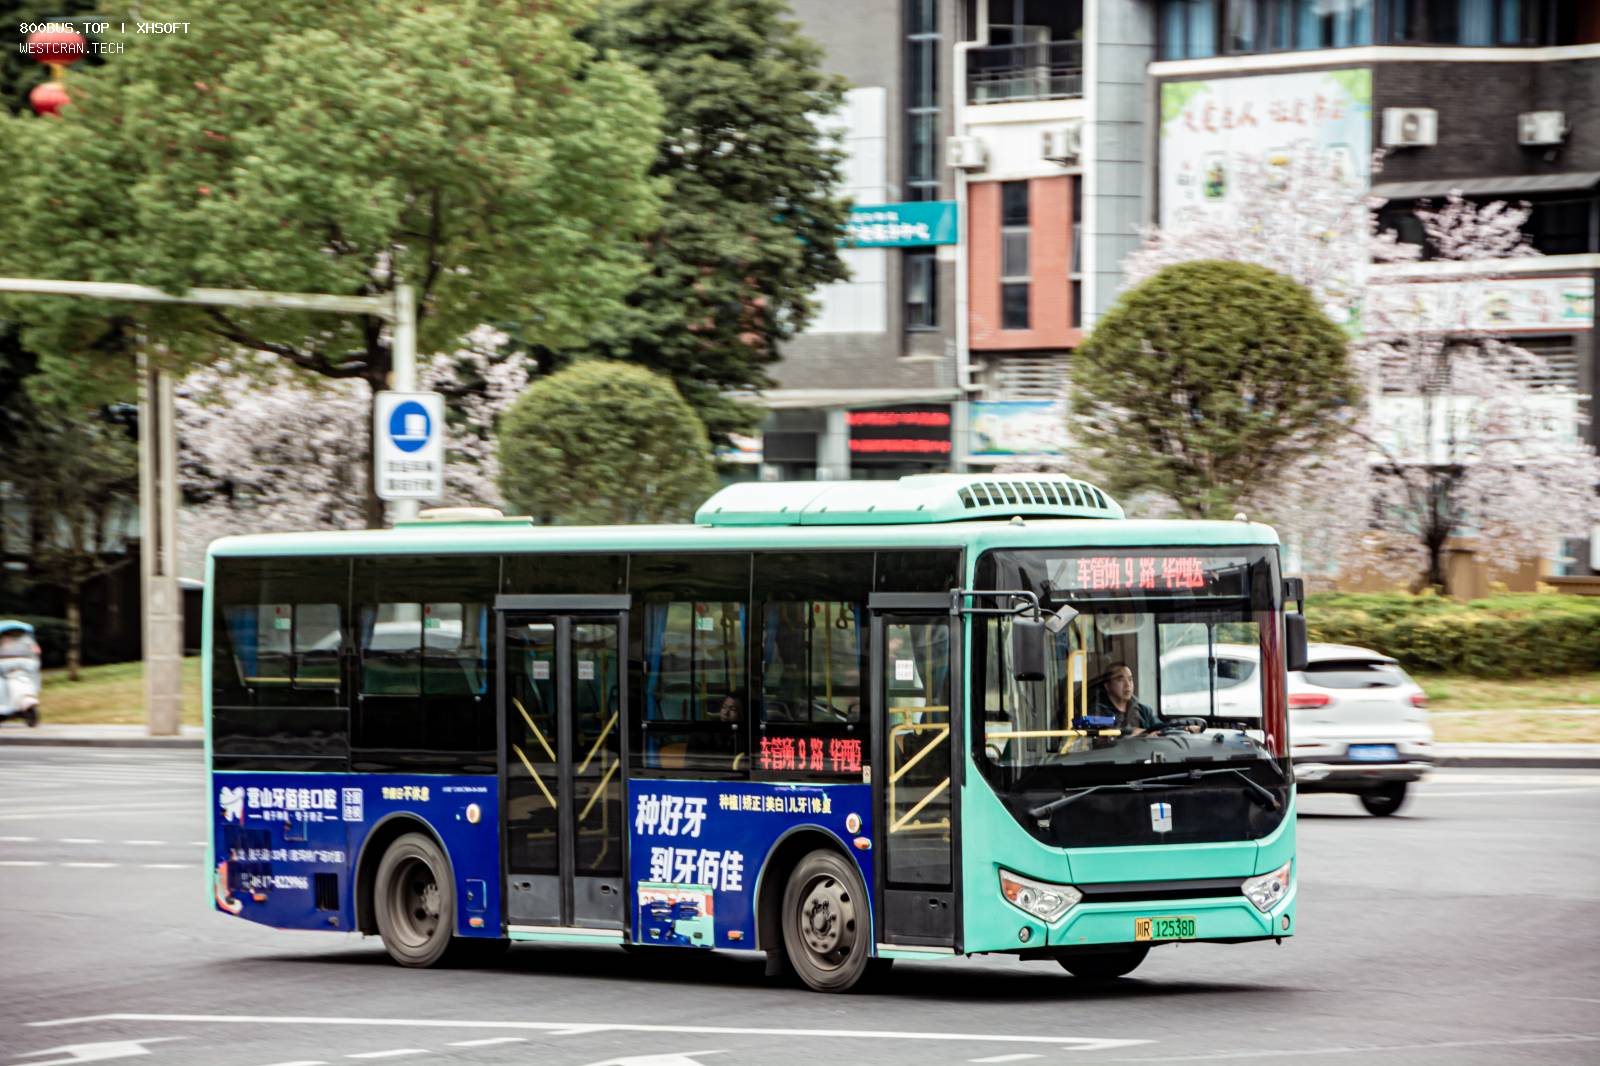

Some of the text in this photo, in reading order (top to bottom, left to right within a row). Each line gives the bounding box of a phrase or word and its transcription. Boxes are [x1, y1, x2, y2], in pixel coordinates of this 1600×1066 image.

[1077, 558, 1120, 589] 车管所
[1125, 558, 1133, 588] 9
[760, 737, 795, 770] 车管所
[798, 738, 806, 769] 9
[635, 794, 708, 838] 种好牙
[649, 847, 744, 892] 到牙佰佳
[1156, 919, 1195, 937] 12538D
